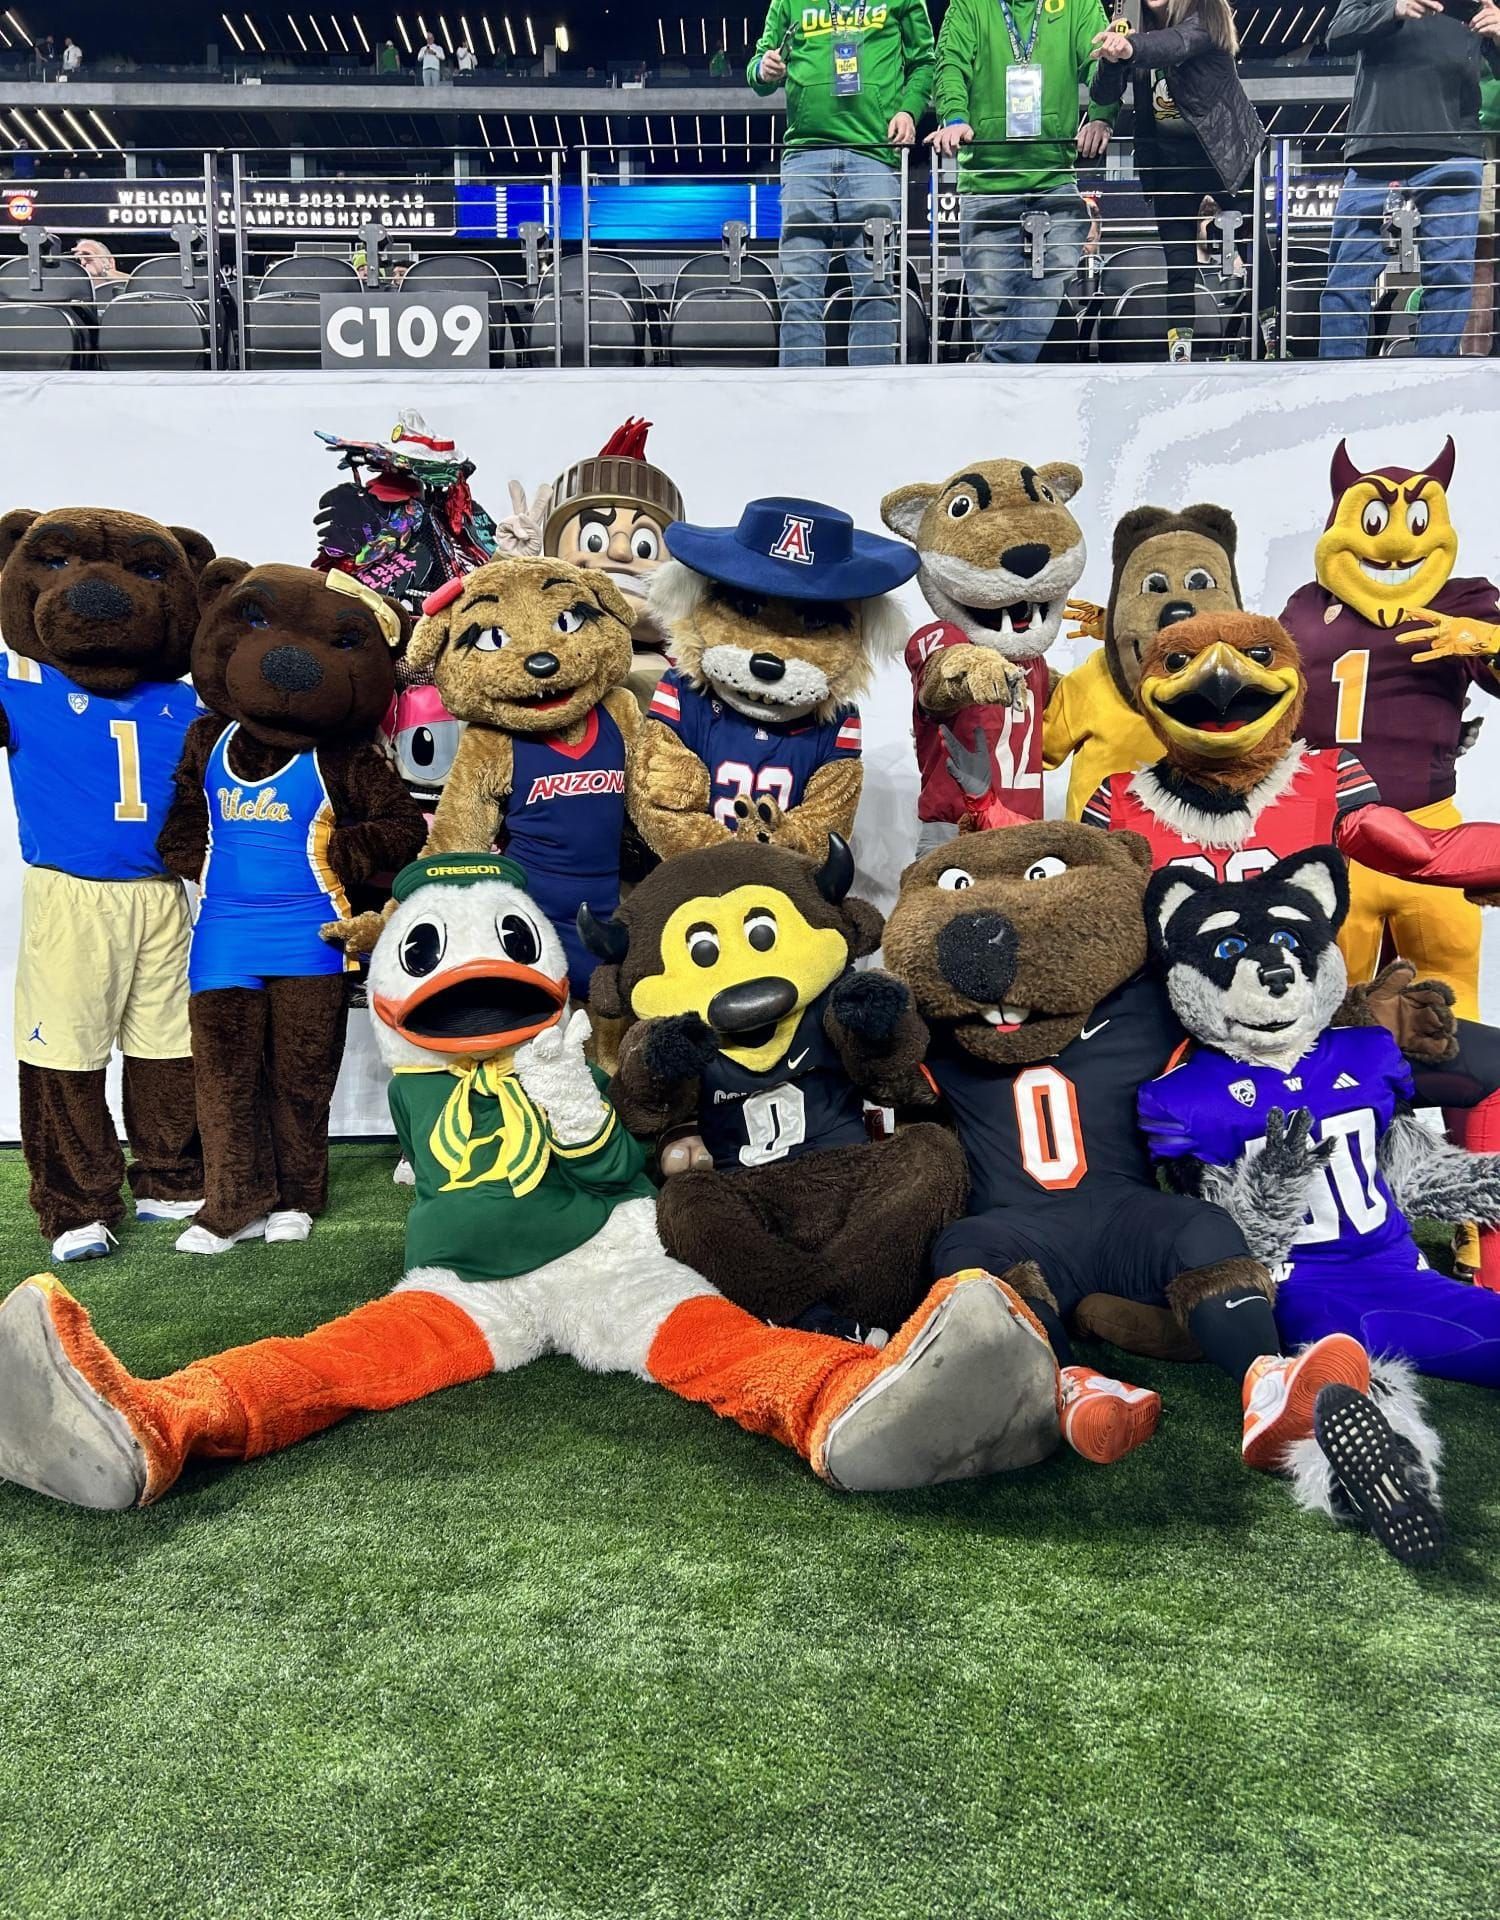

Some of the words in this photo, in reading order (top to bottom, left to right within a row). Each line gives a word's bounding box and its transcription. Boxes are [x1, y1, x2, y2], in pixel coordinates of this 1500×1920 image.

[802, 3, 887, 31] DUCKS
[109, 209, 207, 223] FOOTBALL
[381, 212, 435, 226] GAME
[253, 193, 290, 207] THE
[300, 194, 346, 208] 2023
[355, 194, 424, 208] PAC-12
[326, 305, 483, 358] C109
[769, 514, 814, 565] A
[917, 628, 945, 662] 12
[1332, 650, 1370, 743] 1
[995, 689, 1041, 789] 12
[110, 719, 147, 821] 1
[526, 770, 625, 805] ARIZON
[426, 865, 501, 877] OREGON
[1283, 1077, 1303, 1092] W
[1013, 1065, 1088, 1191] 0
